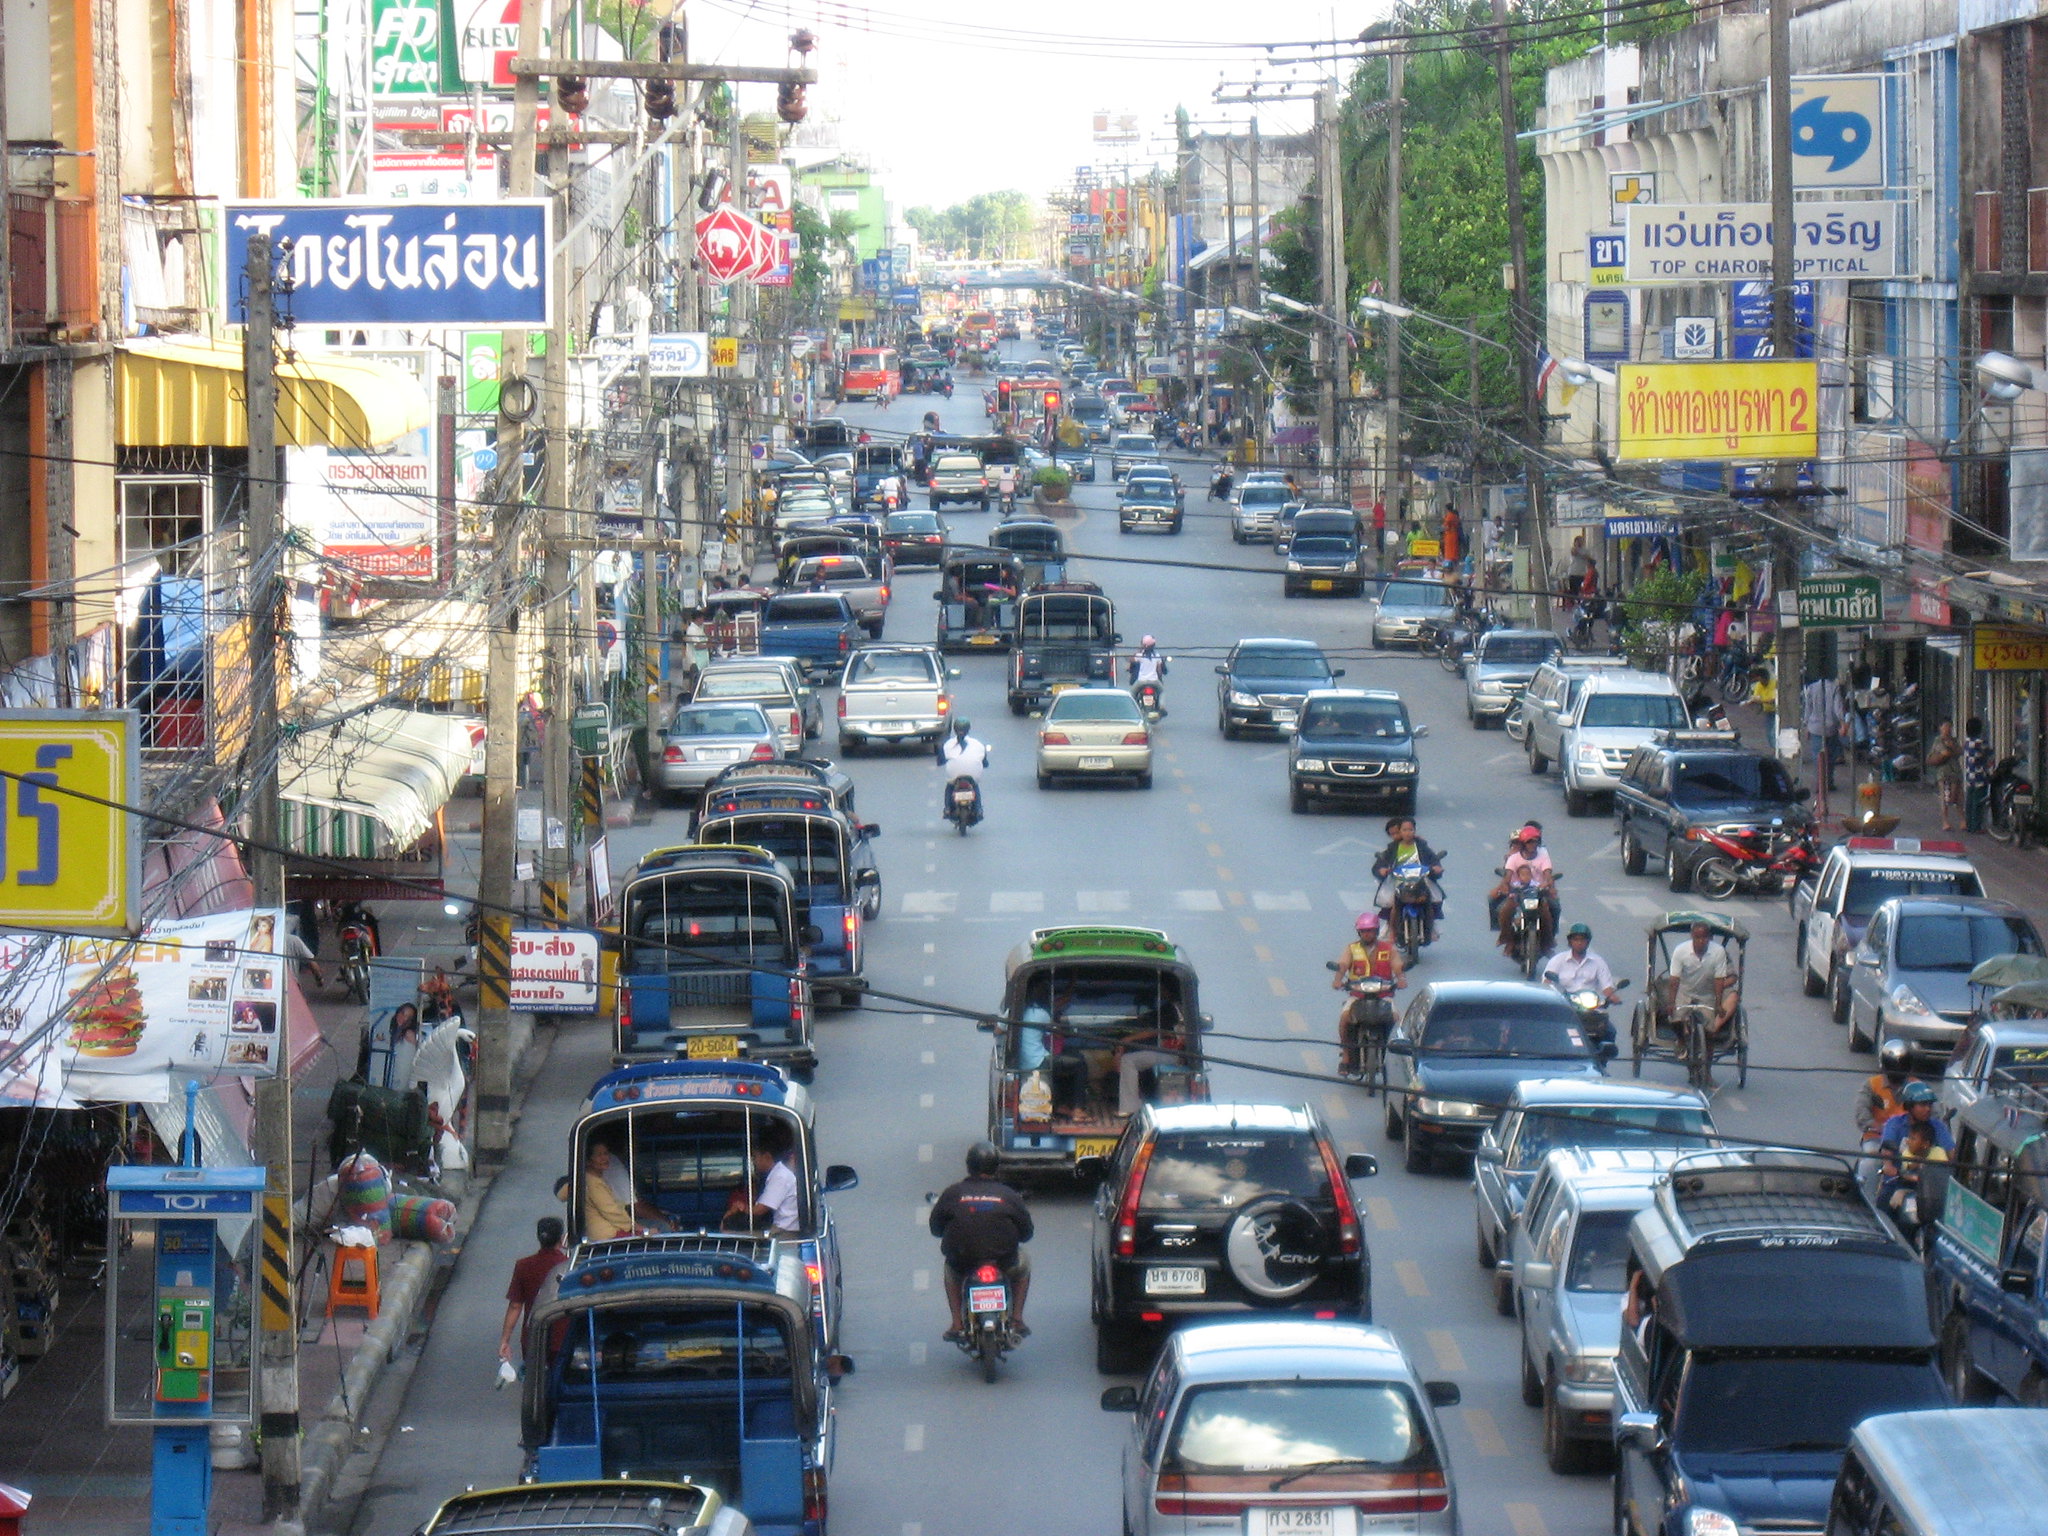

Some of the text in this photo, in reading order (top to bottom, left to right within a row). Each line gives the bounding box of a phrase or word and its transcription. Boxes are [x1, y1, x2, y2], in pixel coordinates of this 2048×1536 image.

[1650, 259, 1687, 274] TOP
[1793, 257, 1870, 273] OPTICAL
[1627, 375, 1809, 449] ห้างทองบูรพา 2
[152, 1193, 218, 1210] TOT
[1171, 1270, 1200, 1283] 6708
[1295, 1509, 1331, 1527] 2631
